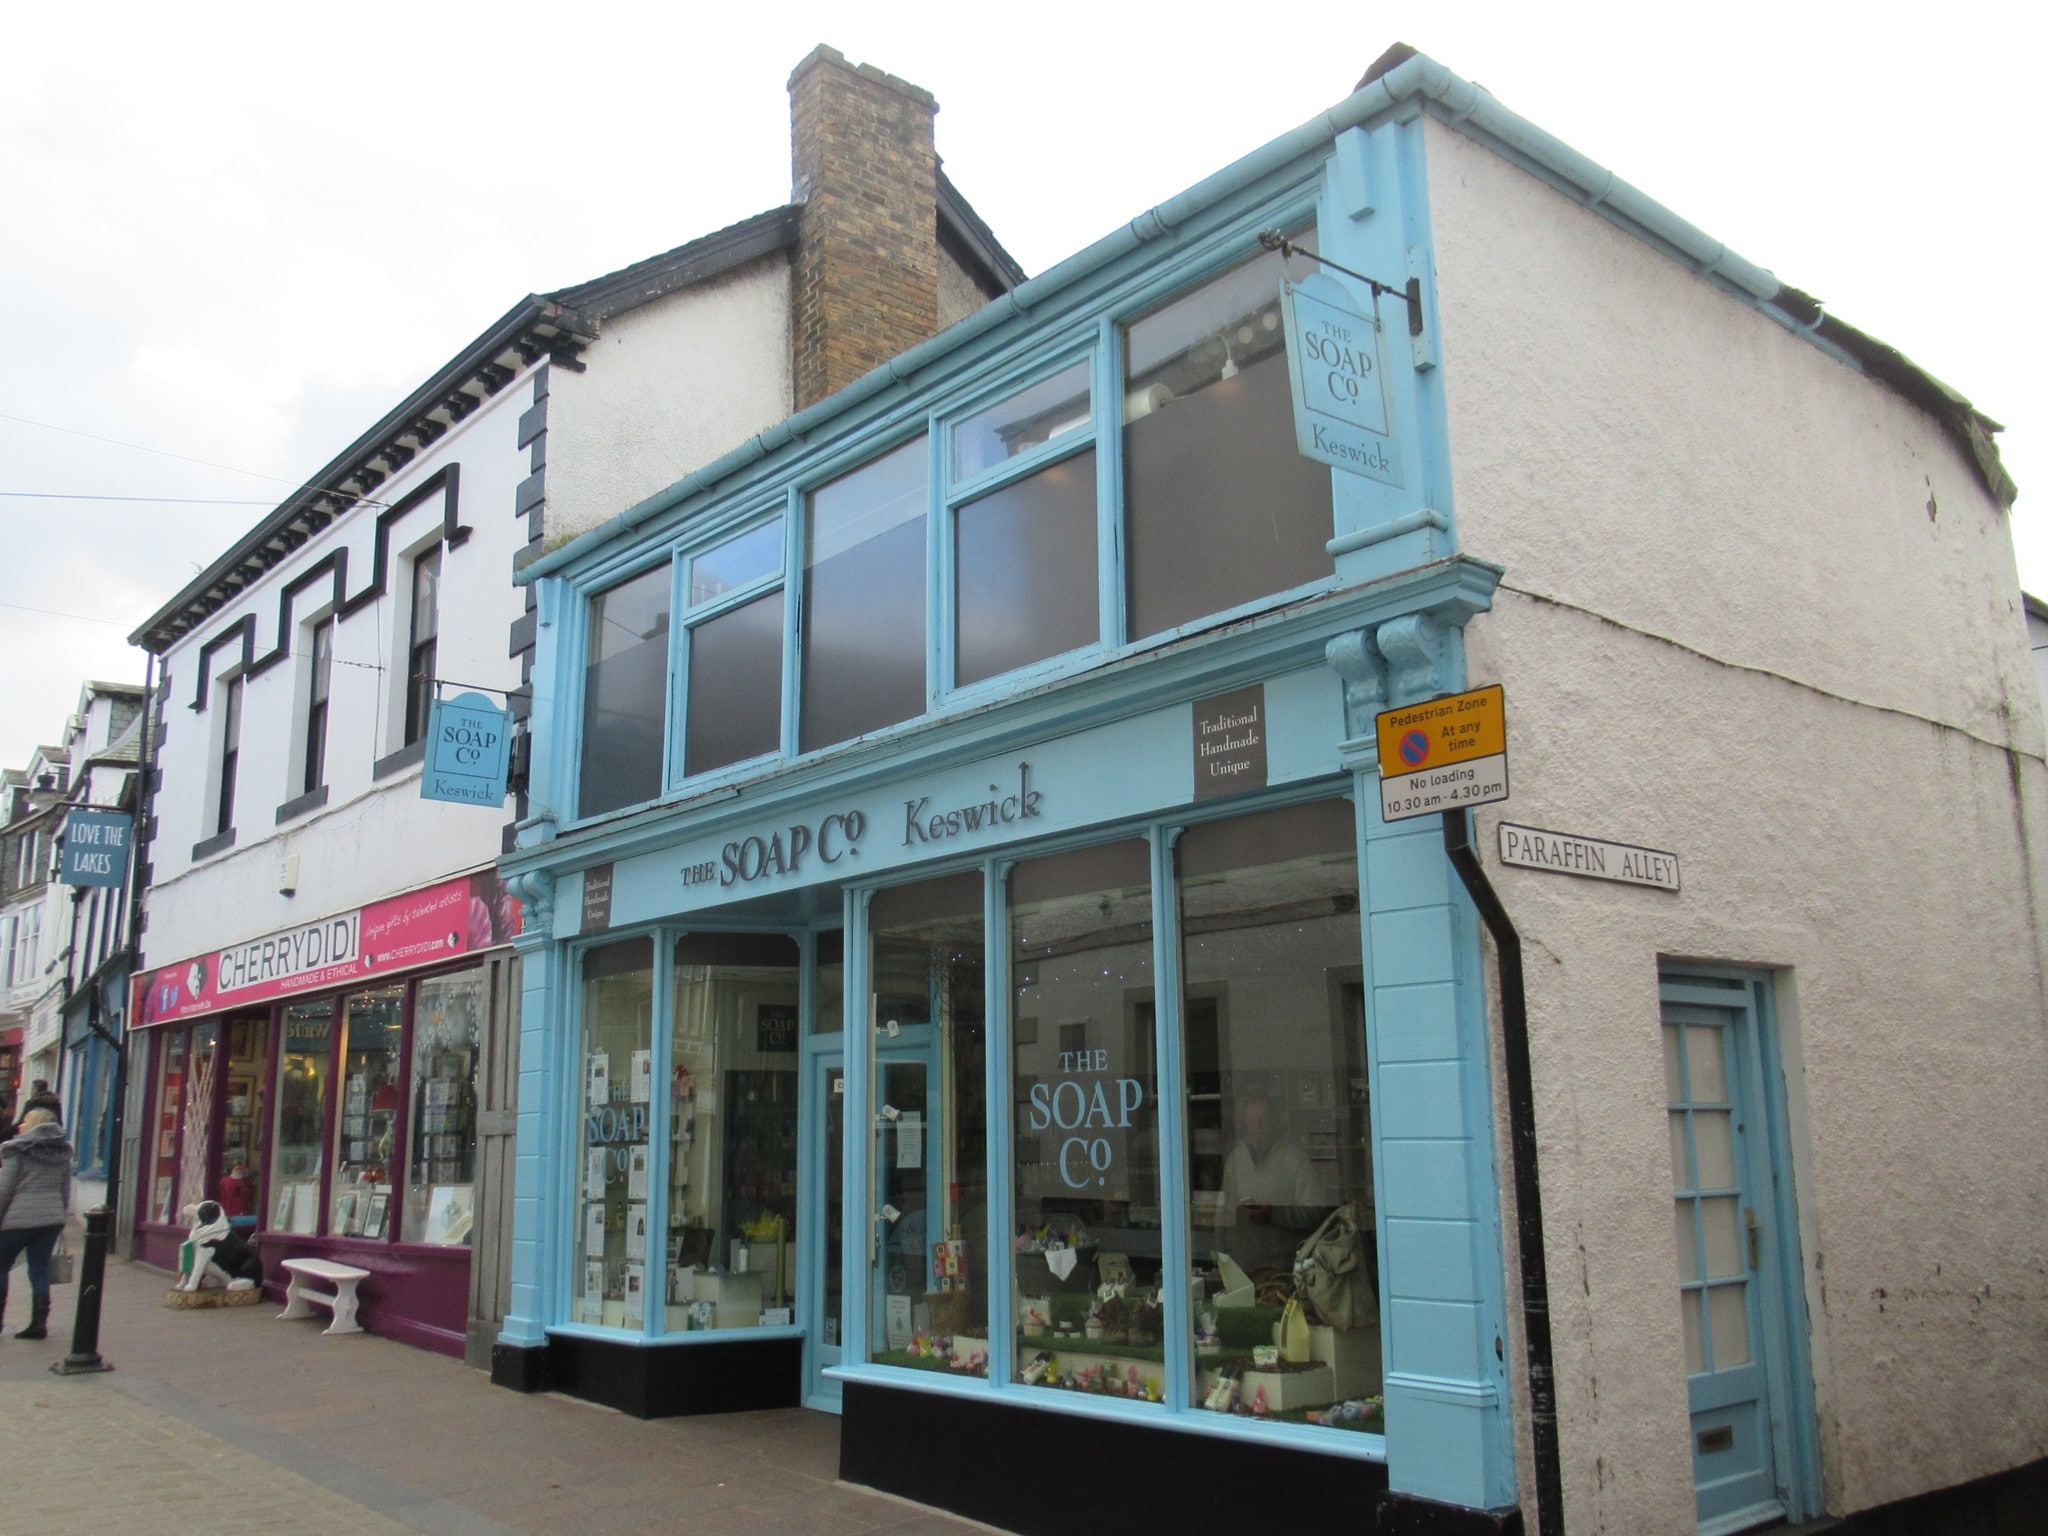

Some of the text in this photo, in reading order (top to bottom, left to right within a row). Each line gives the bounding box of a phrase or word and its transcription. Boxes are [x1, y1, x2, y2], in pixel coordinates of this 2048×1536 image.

[1322, 321, 1351, 343] THE
[1305, 331, 1372, 378] SOAP
[1311, 423, 1390, 472] Keswick
[461, 719, 483, 729] THE
[1200, 705, 1257, 735] Traditional
[1390, 697, 1487, 728] Pedestrian Zone
[444, 727, 496, 748] SOAP
[1441, 720, 1481, 738] At any
[1200, 729, 1259, 756] Handmade
[1448, 738, 1476, 752] time
[1210, 760, 1250, 776] Unique
[1410, 769, 1474, 790] No loading
[435, 779, 494, 800] Keswick
[1387, 797, 1420, 814] 10.30
[1424, 795, 1441, 807] am
[1450, 784, 1480, 800] 4.30
[1483, 782, 1502, 796] pm
[72, 823, 124, 846] LOVE THE
[680, 861, 716, 887] THE
[720, 824, 811, 887] SOAP
[902, 761, 1042, 846] Keswick
[73, 852, 111, 874] LAKES
[1506, 831, 1672, 884] PARAFFIN ALLEY
[219, 916, 357, 989] CHERRYDIDI
[280, 964, 358, 989] HANDMADE & ETHICAL
[1060, 1049, 1108, 1073] THE
[1030, 1078, 1143, 1130] SOAP
[588, 1106, 644, 1142] SOAP
